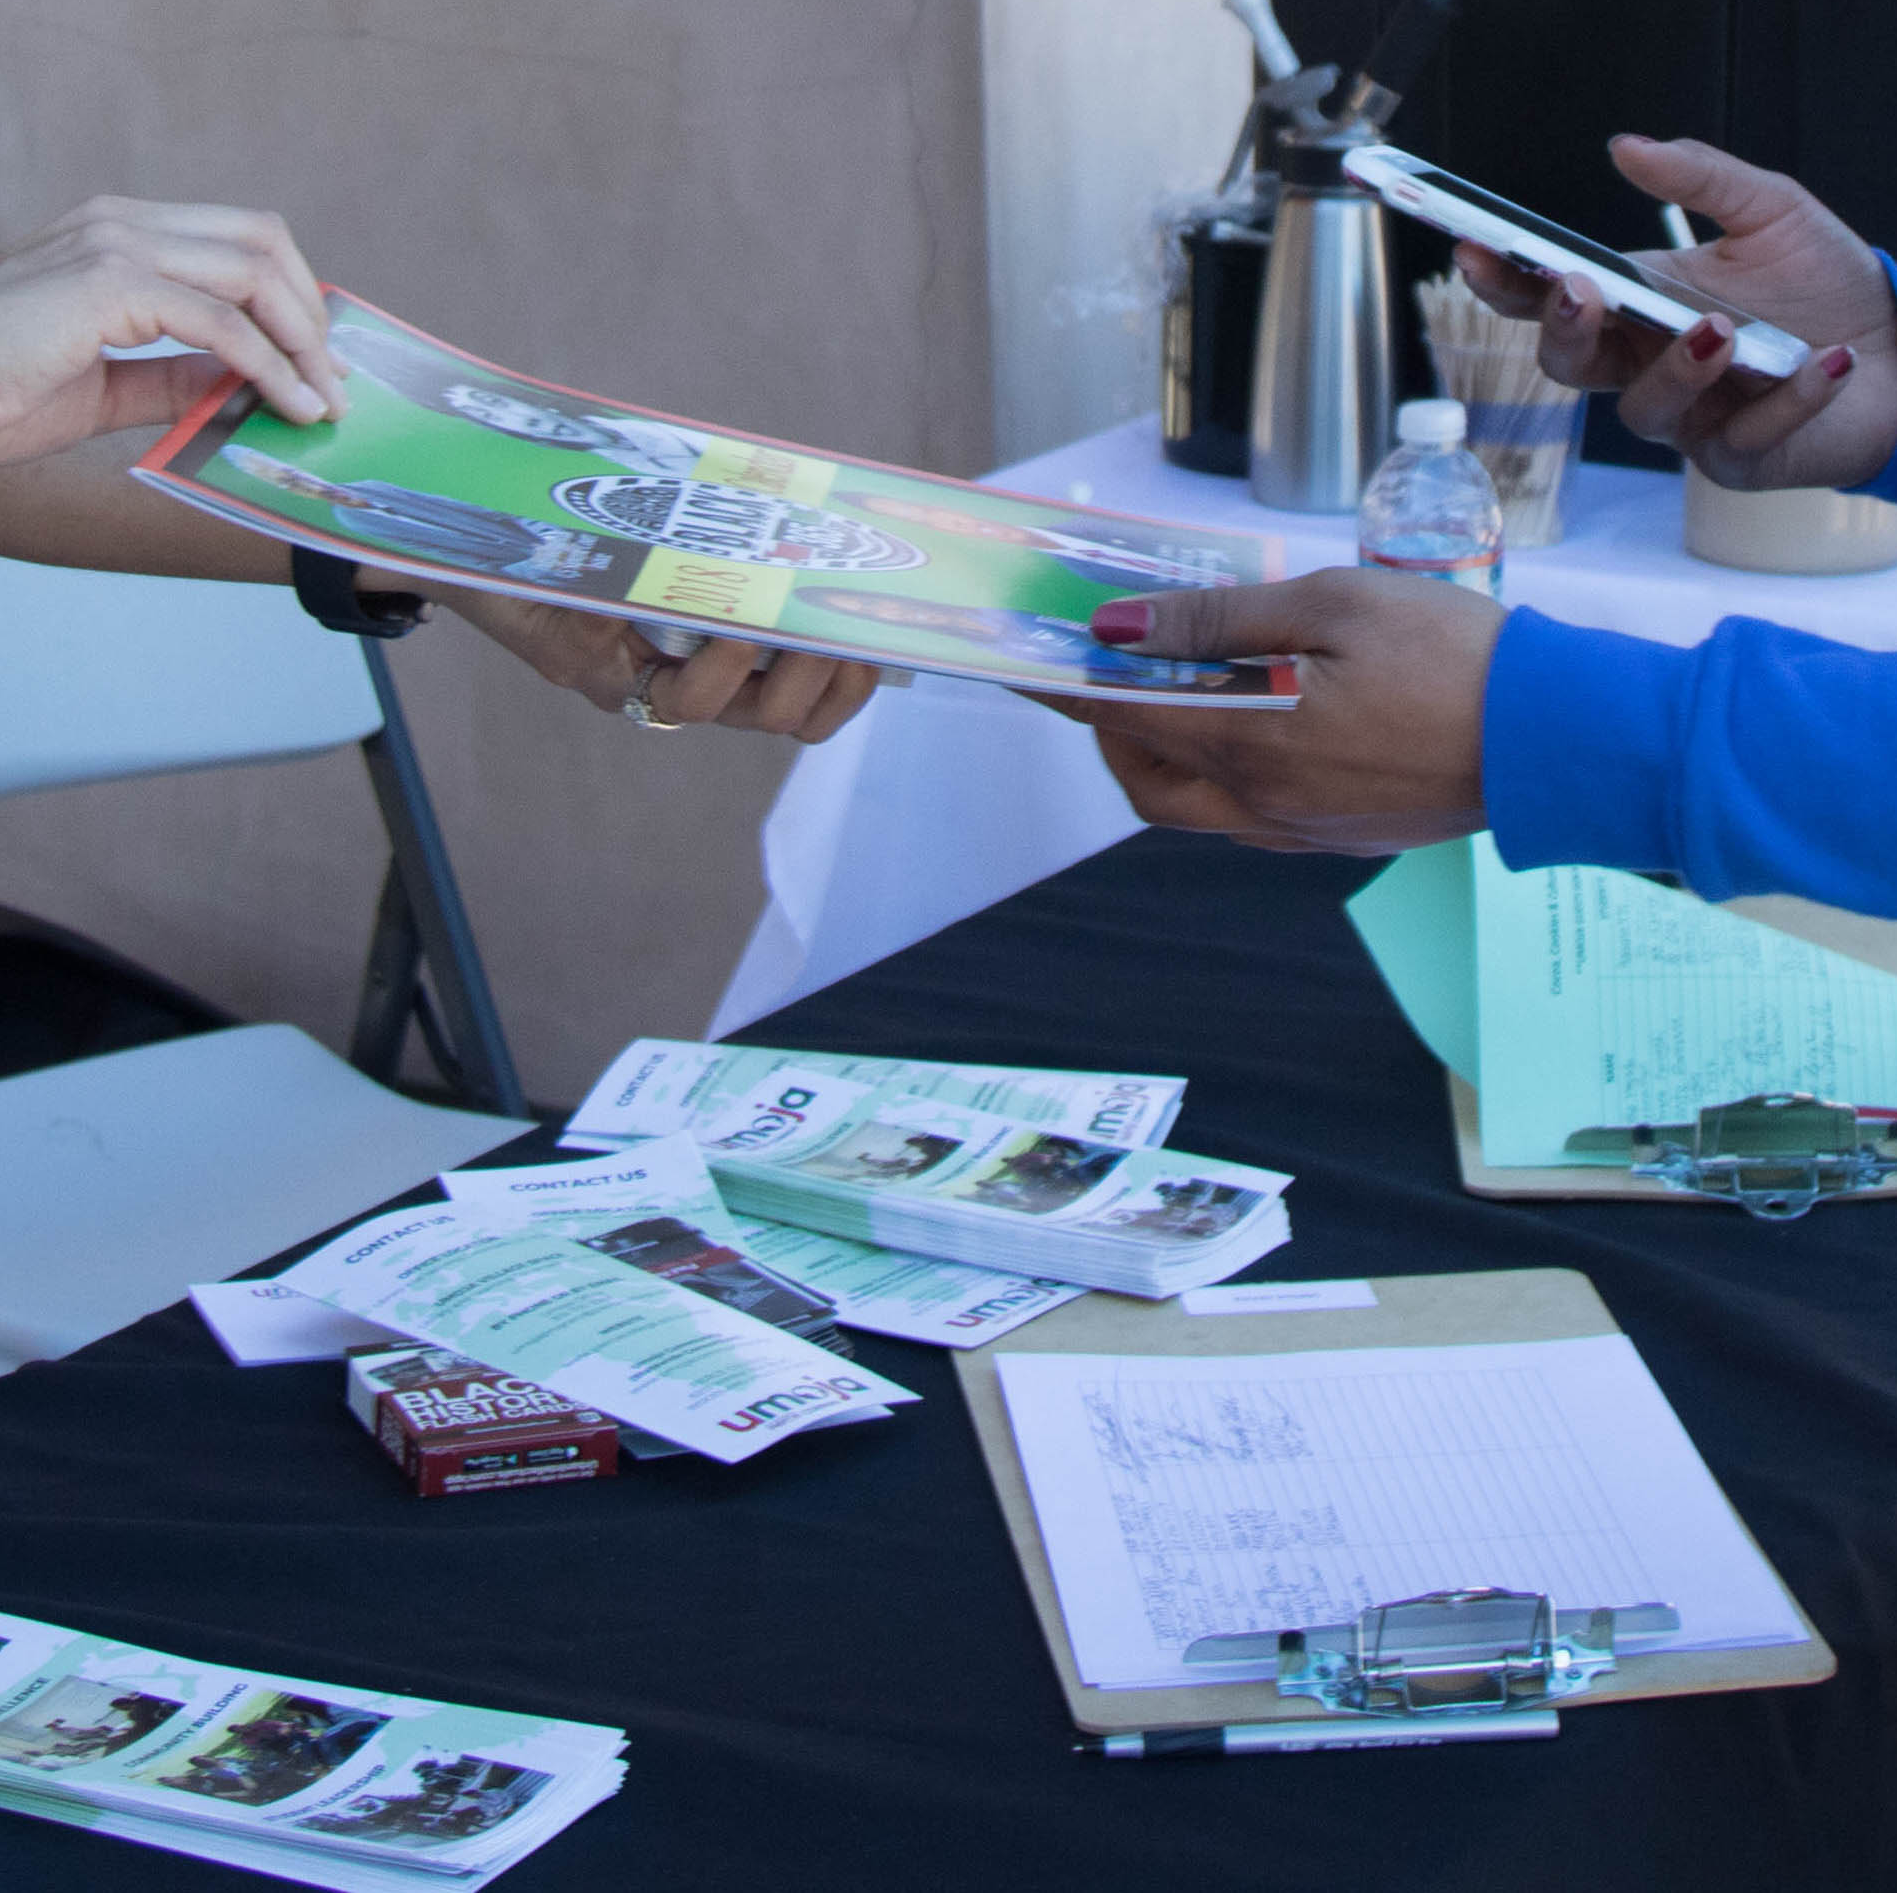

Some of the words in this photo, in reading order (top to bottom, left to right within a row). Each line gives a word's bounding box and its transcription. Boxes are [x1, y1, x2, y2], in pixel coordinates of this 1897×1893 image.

[663, 564, 751, 615] 2018
[509, 1174, 613, 1194] CONTACT
[617, 1167, 649, 1183] US
[344, 1219, 429, 1265] CONTACT
[392, 1376, 537, 1409] BLAC
[402, 1390, 560, 1424] HISTOR
[717, 1374, 872, 1434] umoja
[414, 1411, 500, 1432] FLASH
[192, 1681, 250, 1729] BUILDING
